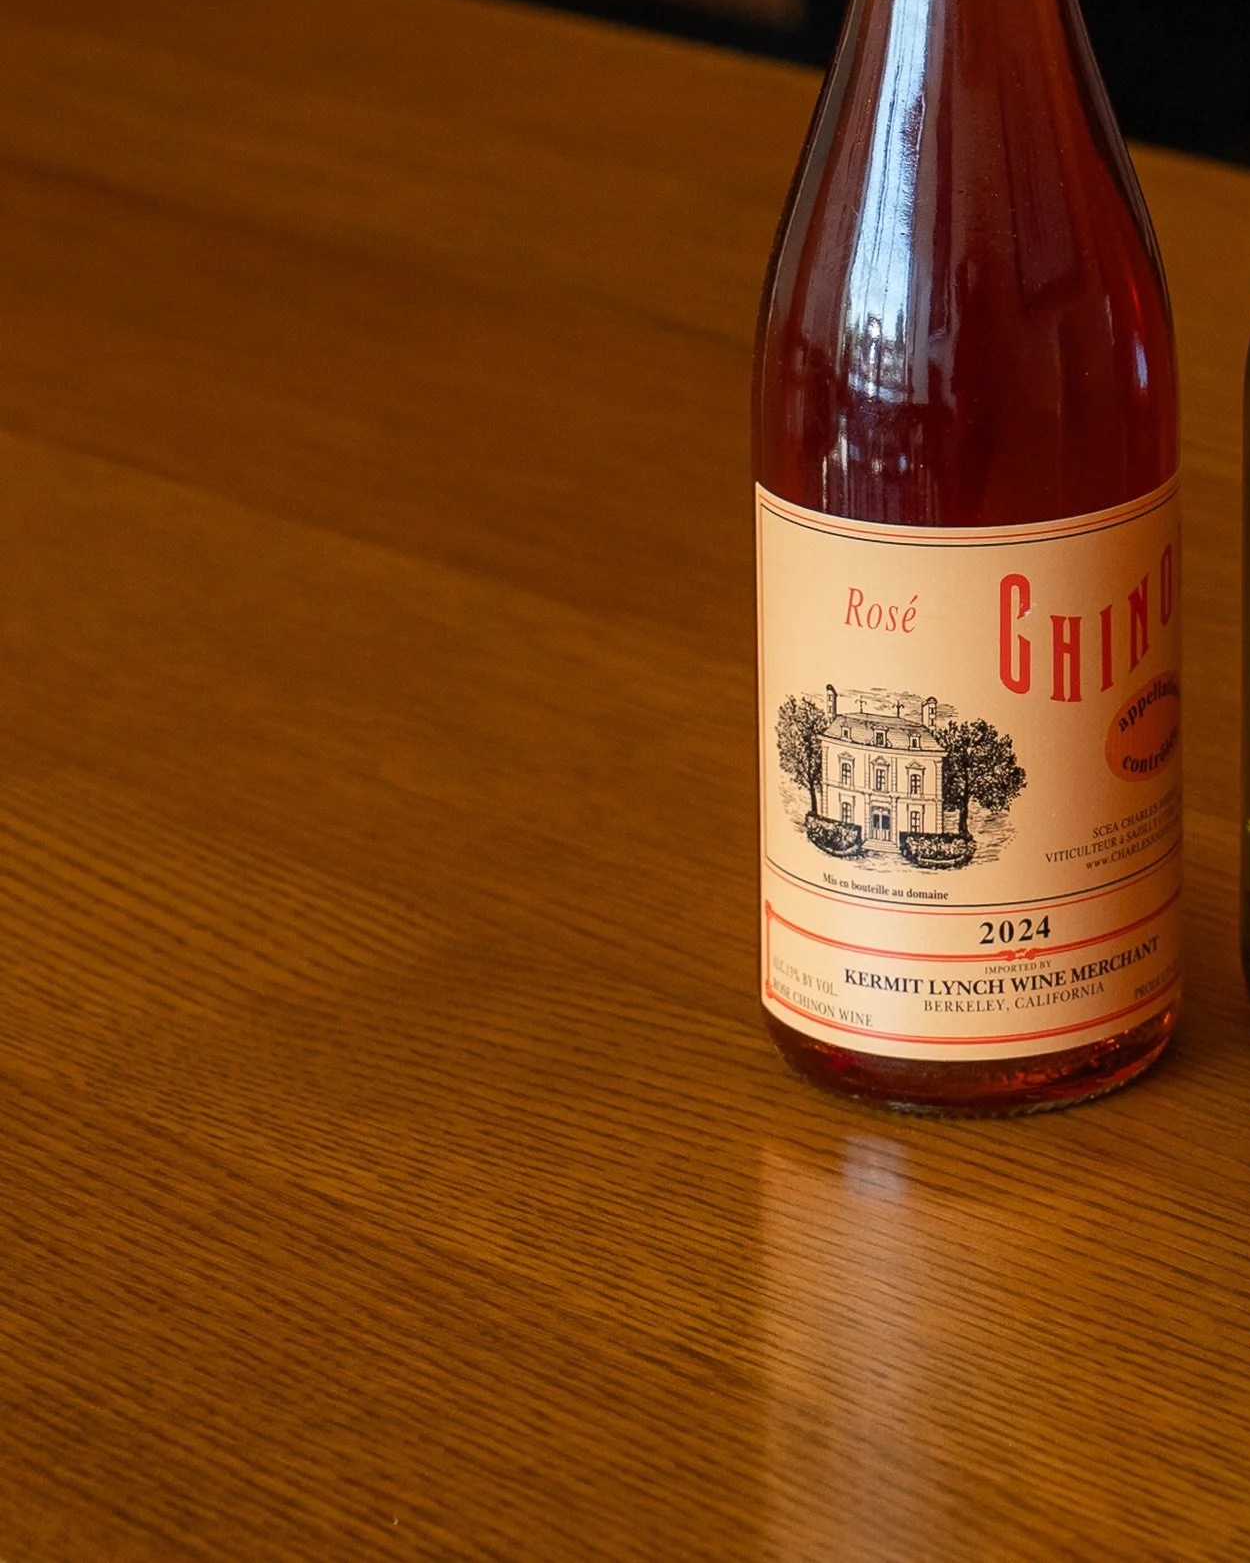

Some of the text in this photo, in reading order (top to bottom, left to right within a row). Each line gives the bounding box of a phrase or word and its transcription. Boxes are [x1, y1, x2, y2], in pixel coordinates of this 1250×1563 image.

[844, 587, 919, 634] Rosé
[999, 524, 1181, 703] CHINO
[1092, 822, 1119, 839] SCEA
[1044, 837, 1118, 863] VITICULTEUR
[823, 872, 949, 901] Mis en bouteille au domaine
[979, 915, 1052, 946] 2024
[844, 967, 923, 995] KERMIT
[928, 978, 1004, 997] LYNCH
[1005, 969, 1067, 993] WINE
[1070, 934, 1160, 983] MERCHANT
[984, 959, 1052, 975] IMPORTED BY
[792, 991, 836, 1018] CHINON
[838, 1007, 873, 1027] WINE
[923, 981, 1105, 1013] BERKELEY, CALIFORNIA
